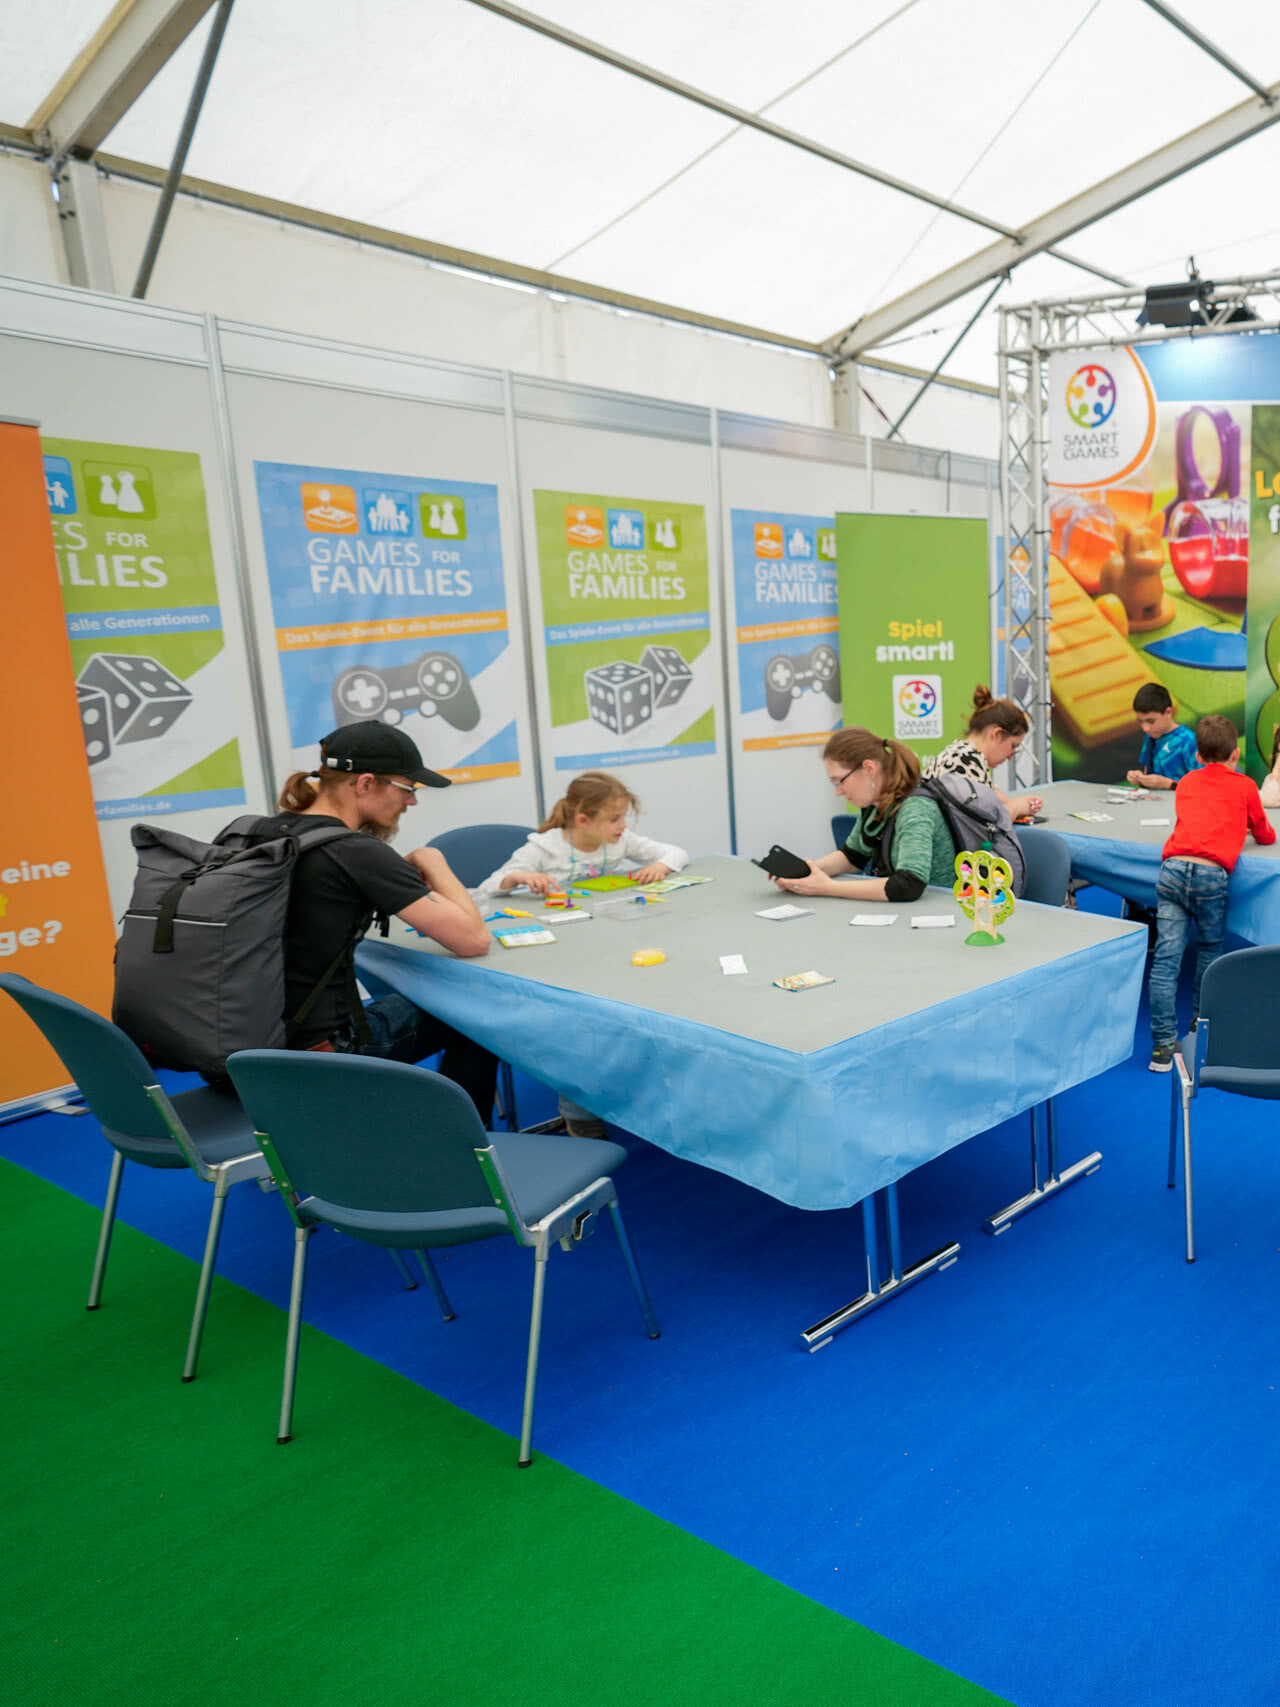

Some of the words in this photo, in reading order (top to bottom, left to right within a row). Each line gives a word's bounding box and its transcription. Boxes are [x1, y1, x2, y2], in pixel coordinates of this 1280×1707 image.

[1064, 432, 1119, 447] SMART
[1063, 446, 1120, 460] GAMES
[104, 531, 149, 548] FOR
[307, 537, 422, 567] GAMES
[432, 551, 461, 564] FOR
[567, 551, 649, 576] GAMES
[755, 561, 816, 582] GAMES
[310, 565, 473, 597] FAMILIES
[568, 573, 687, 600] FAMILIES
[70, 618, 101, 632] alle
[104, 613, 210, 630] Generationen
[888, 618, 943, 641] Spiel
[876, 640, 954, 662] smart!
[0, 919, 63, 957] ge?
